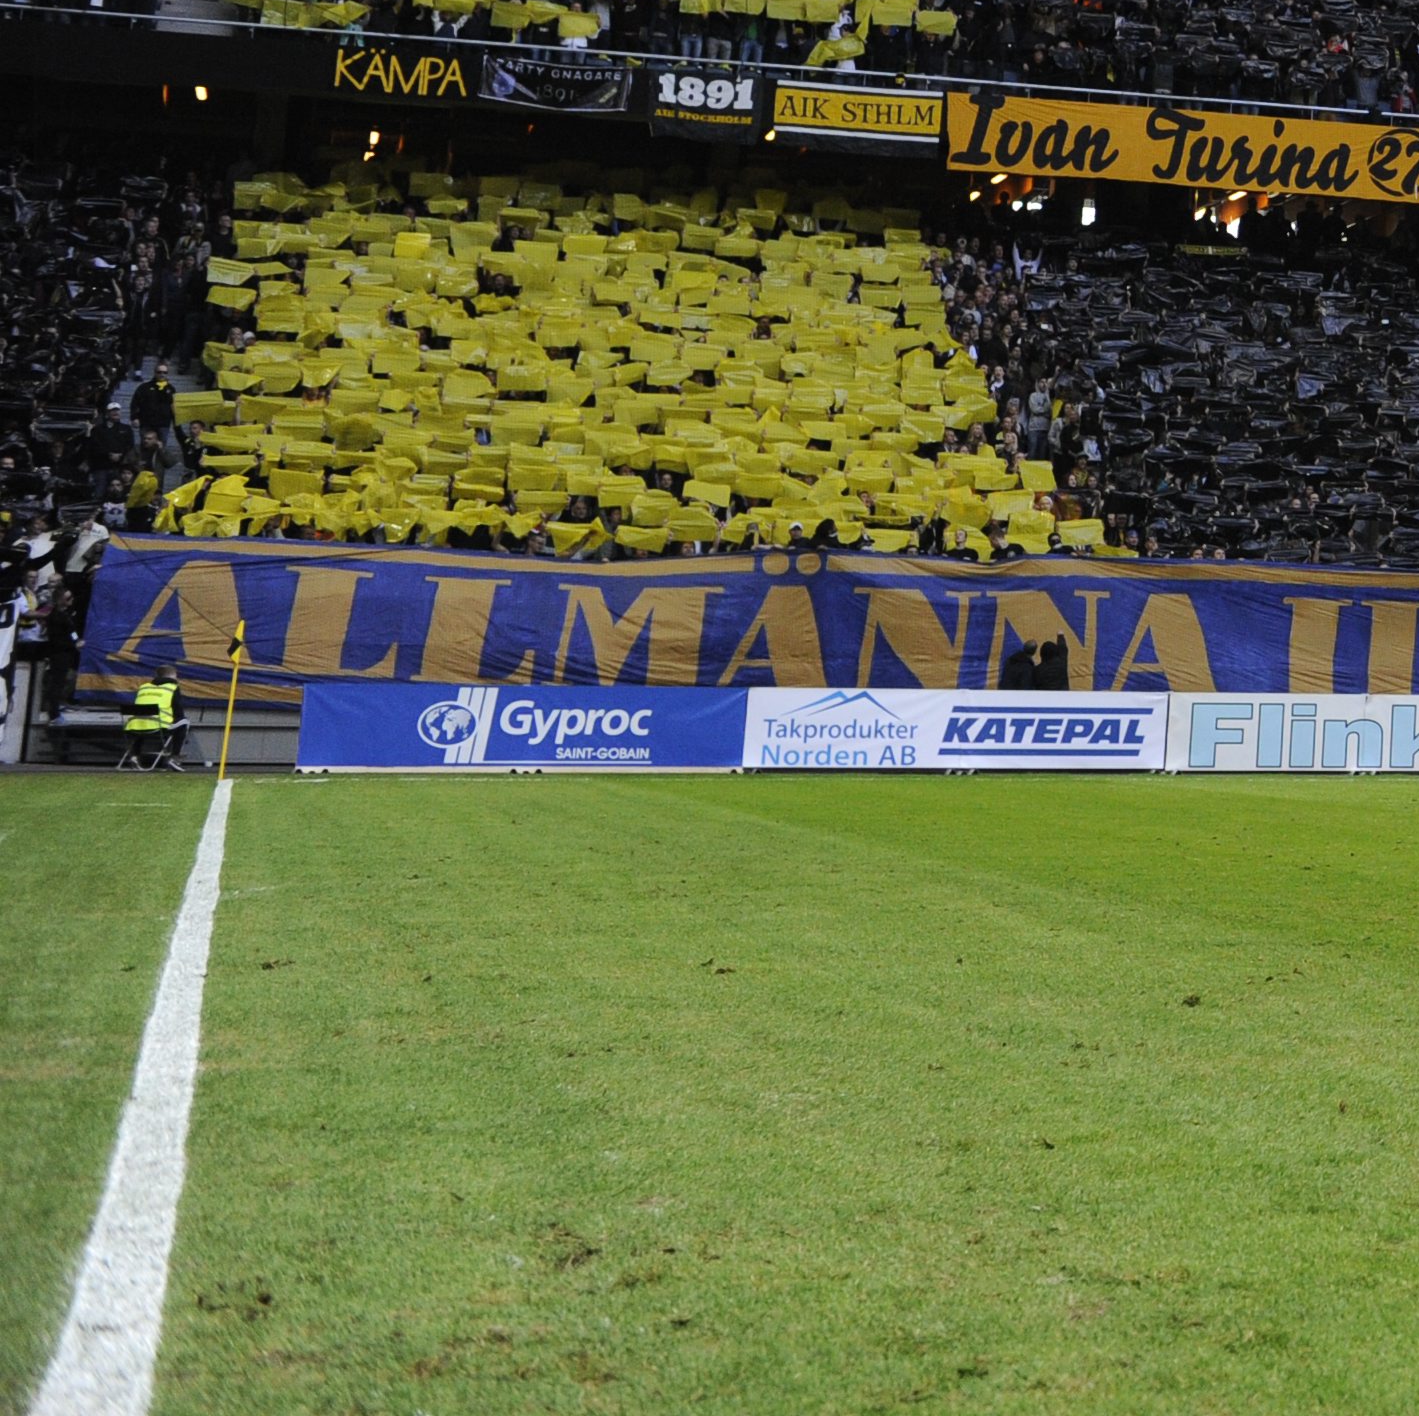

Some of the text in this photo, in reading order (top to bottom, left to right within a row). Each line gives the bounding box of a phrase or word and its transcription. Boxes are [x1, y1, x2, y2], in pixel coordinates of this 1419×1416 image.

[334, 48, 467, 97] KÄMPA
[658, 72, 754, 110] 1891
[678, 111, 753, 125] STOCKHOLM
[780, 94, 936, 127] AIK STHLM
[951, 92, 1119, 173] Ivan
[1146, 107, 1360, 193] Turina
[106, 552, 1217, 691] ALLMÄNNA
[500, 699, 651, 744] Gyproc
[764, 718, 918, 744] Takprodukter
[943, 718, 1145, 745] KATEPAL
[556, 747, 651, 760] SAINT-GOBAIN
[761, 744, 916, 766] Norden AB
